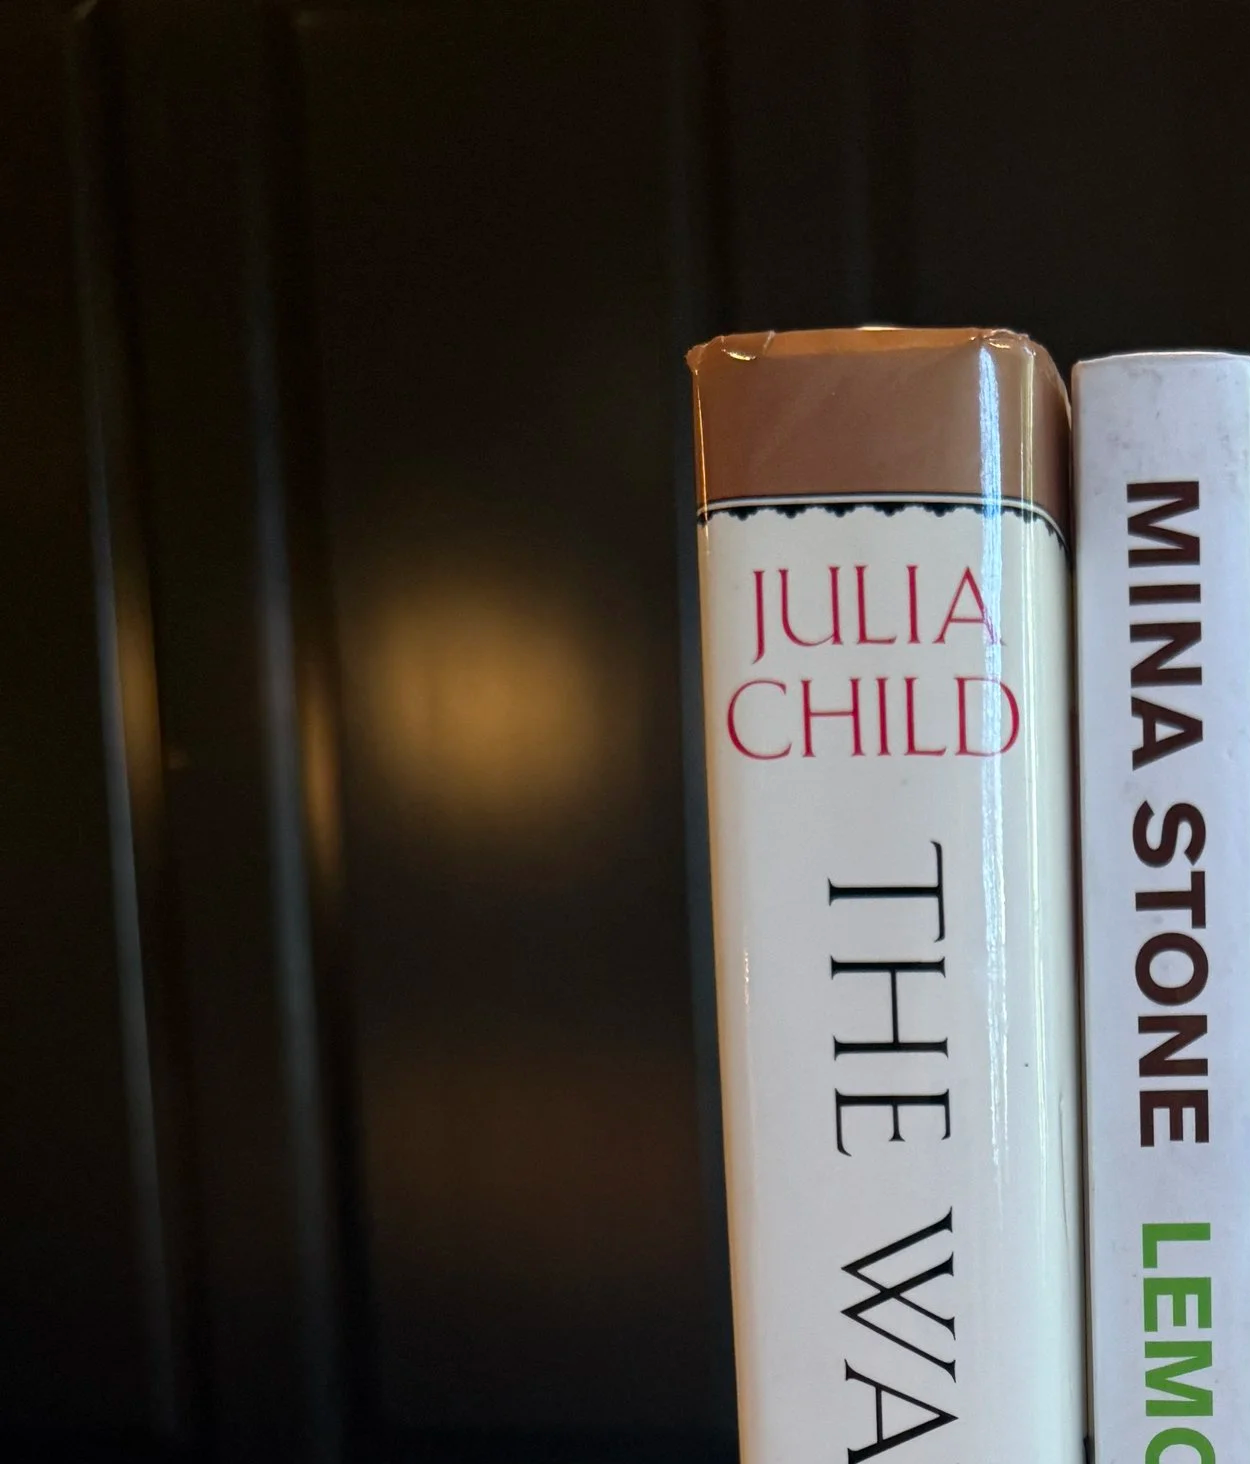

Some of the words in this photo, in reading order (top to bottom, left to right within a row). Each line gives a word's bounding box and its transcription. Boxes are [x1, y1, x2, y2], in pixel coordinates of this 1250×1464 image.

[726, 677, 1020, 760] CHILD
[752, 565, 1007, 664] JULIA
[1126, 481, 1203, 771] MINA
[828, 841, 951, 1156] THE
[1132, 800, 1209, 1147] STONE
